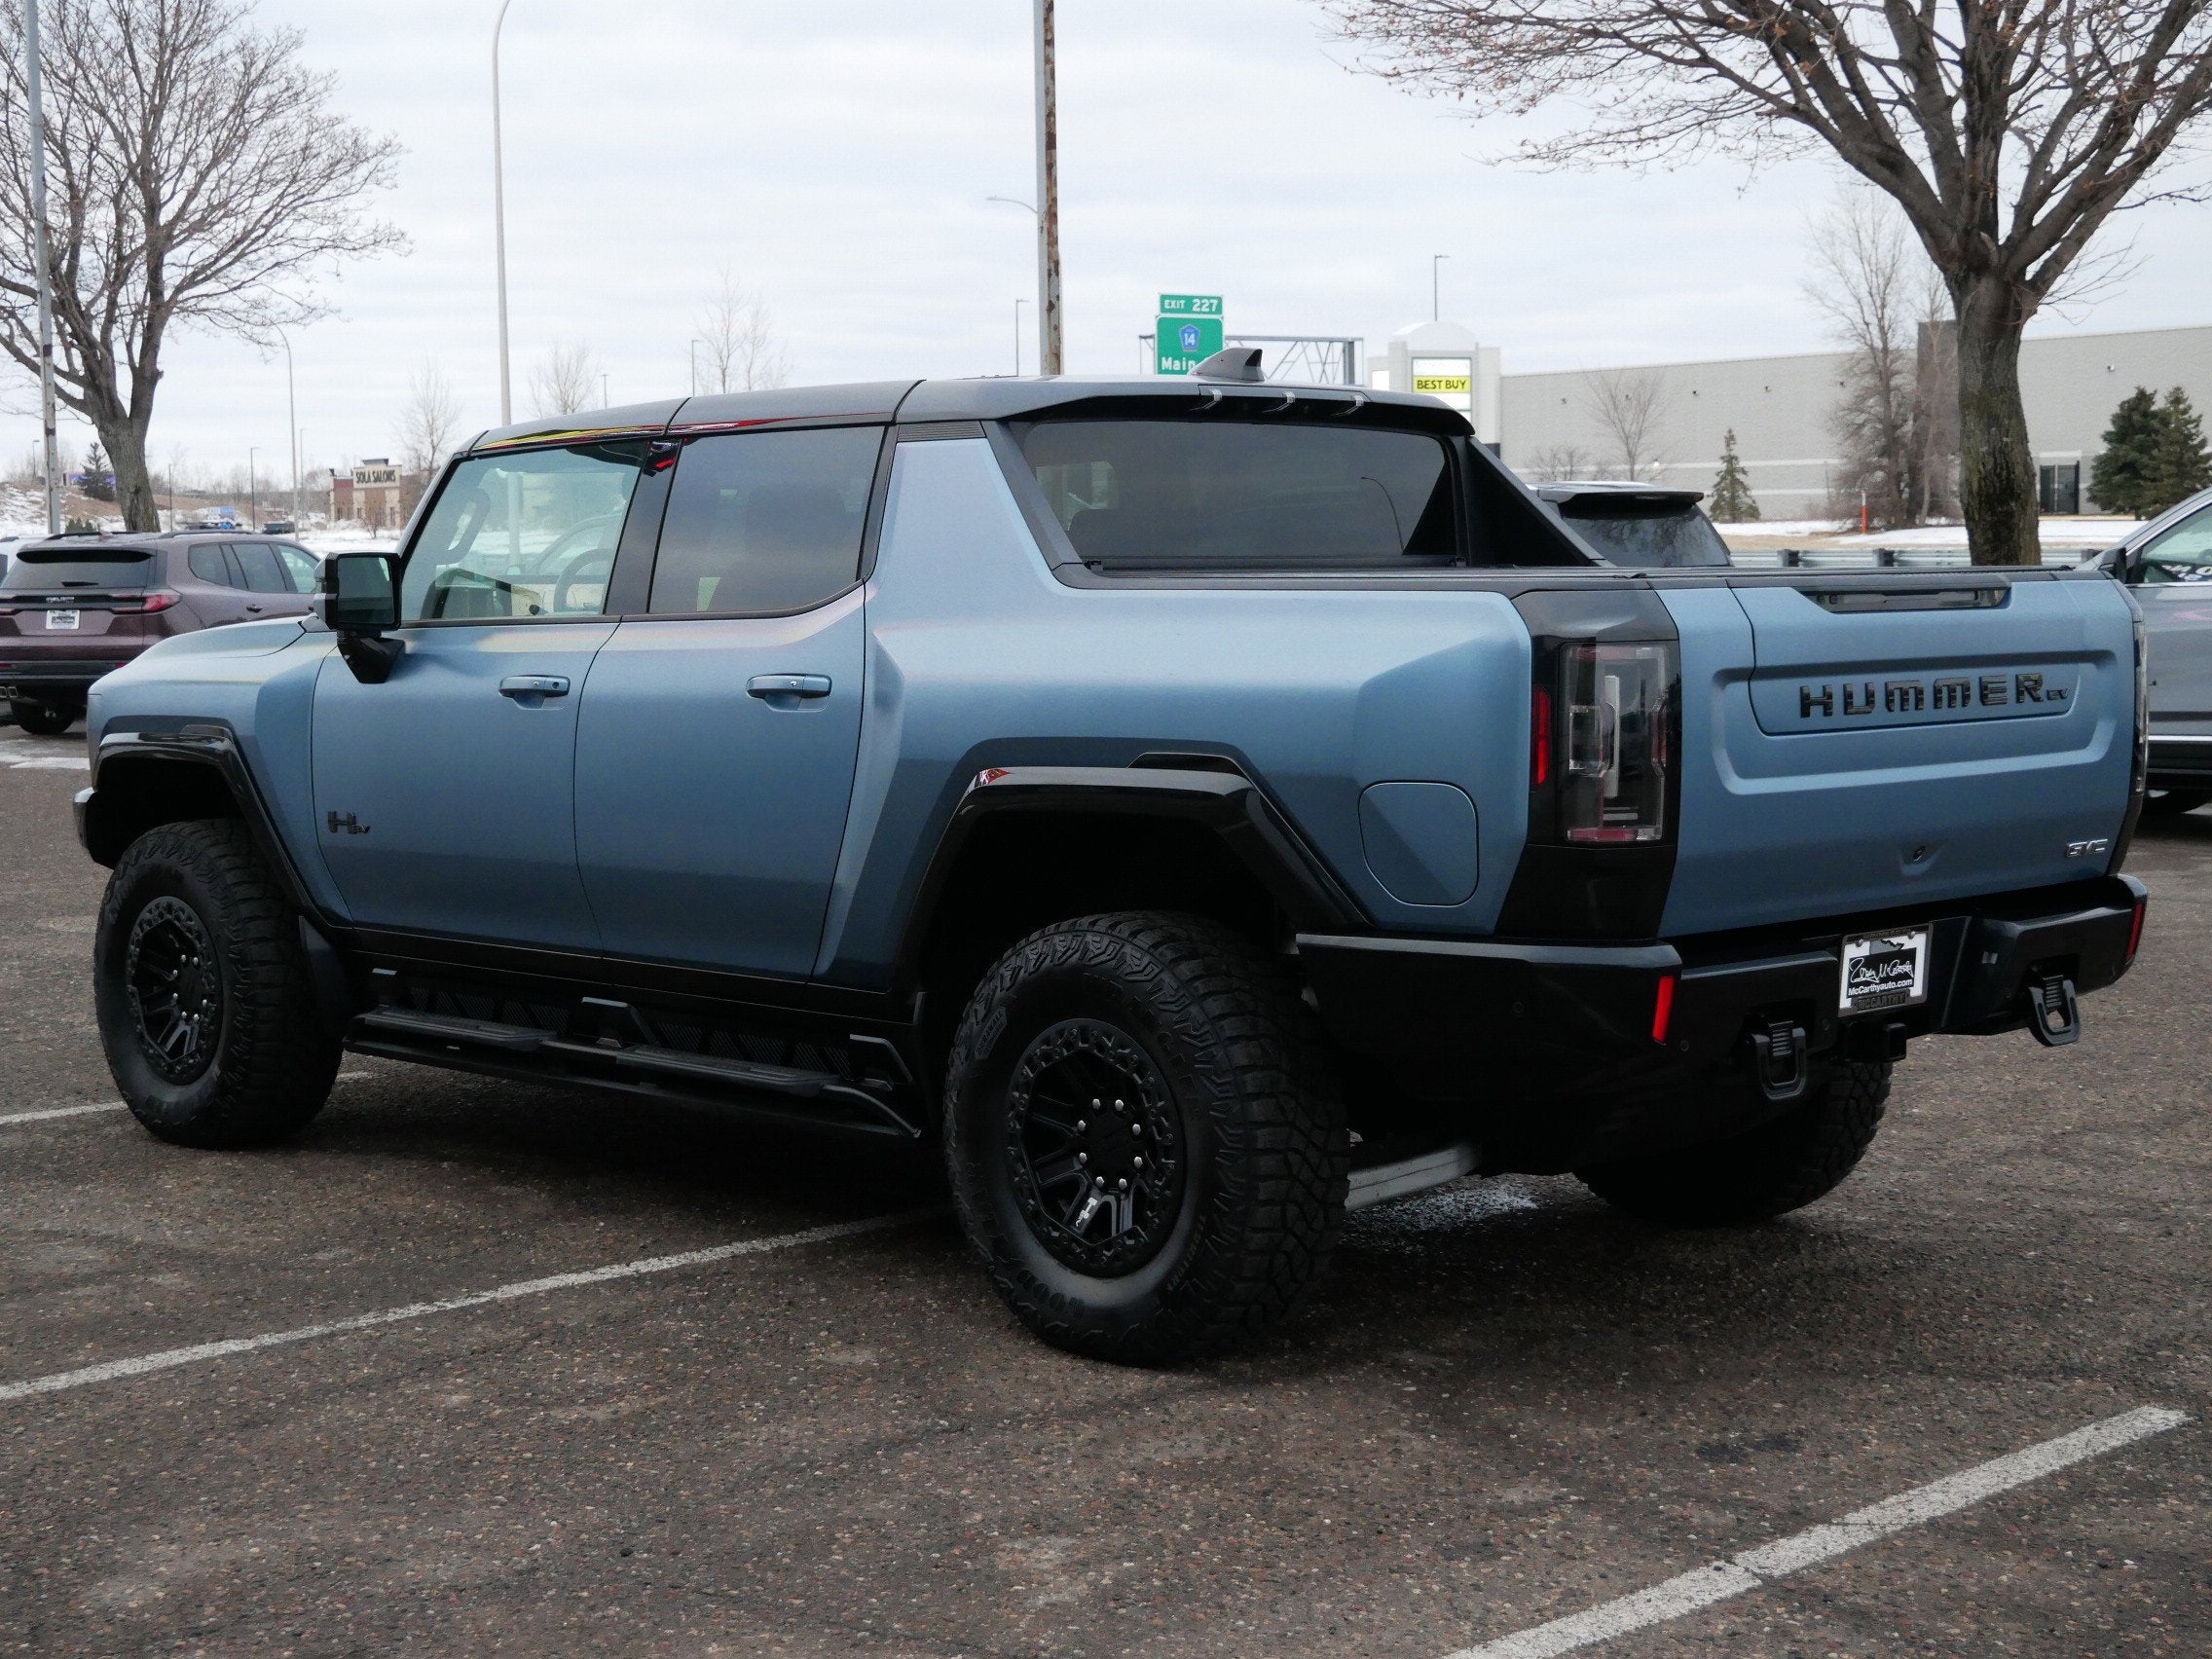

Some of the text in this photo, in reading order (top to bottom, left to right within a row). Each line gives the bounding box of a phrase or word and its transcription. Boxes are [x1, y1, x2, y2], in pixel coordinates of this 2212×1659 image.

[1163, 298, 1219, 313] EXIT 227
[1184, 332, 1196, 346] 14
[1161, 356, 1198, 371] Main
[1417, 380, 1466, 389] BEST BUY
[355, 469, 396, 485] SOLA SALONS
[1800, 672, 2044, 719] HUMMER
[1848, 978, 1913, 996] McCarthyauto.com
